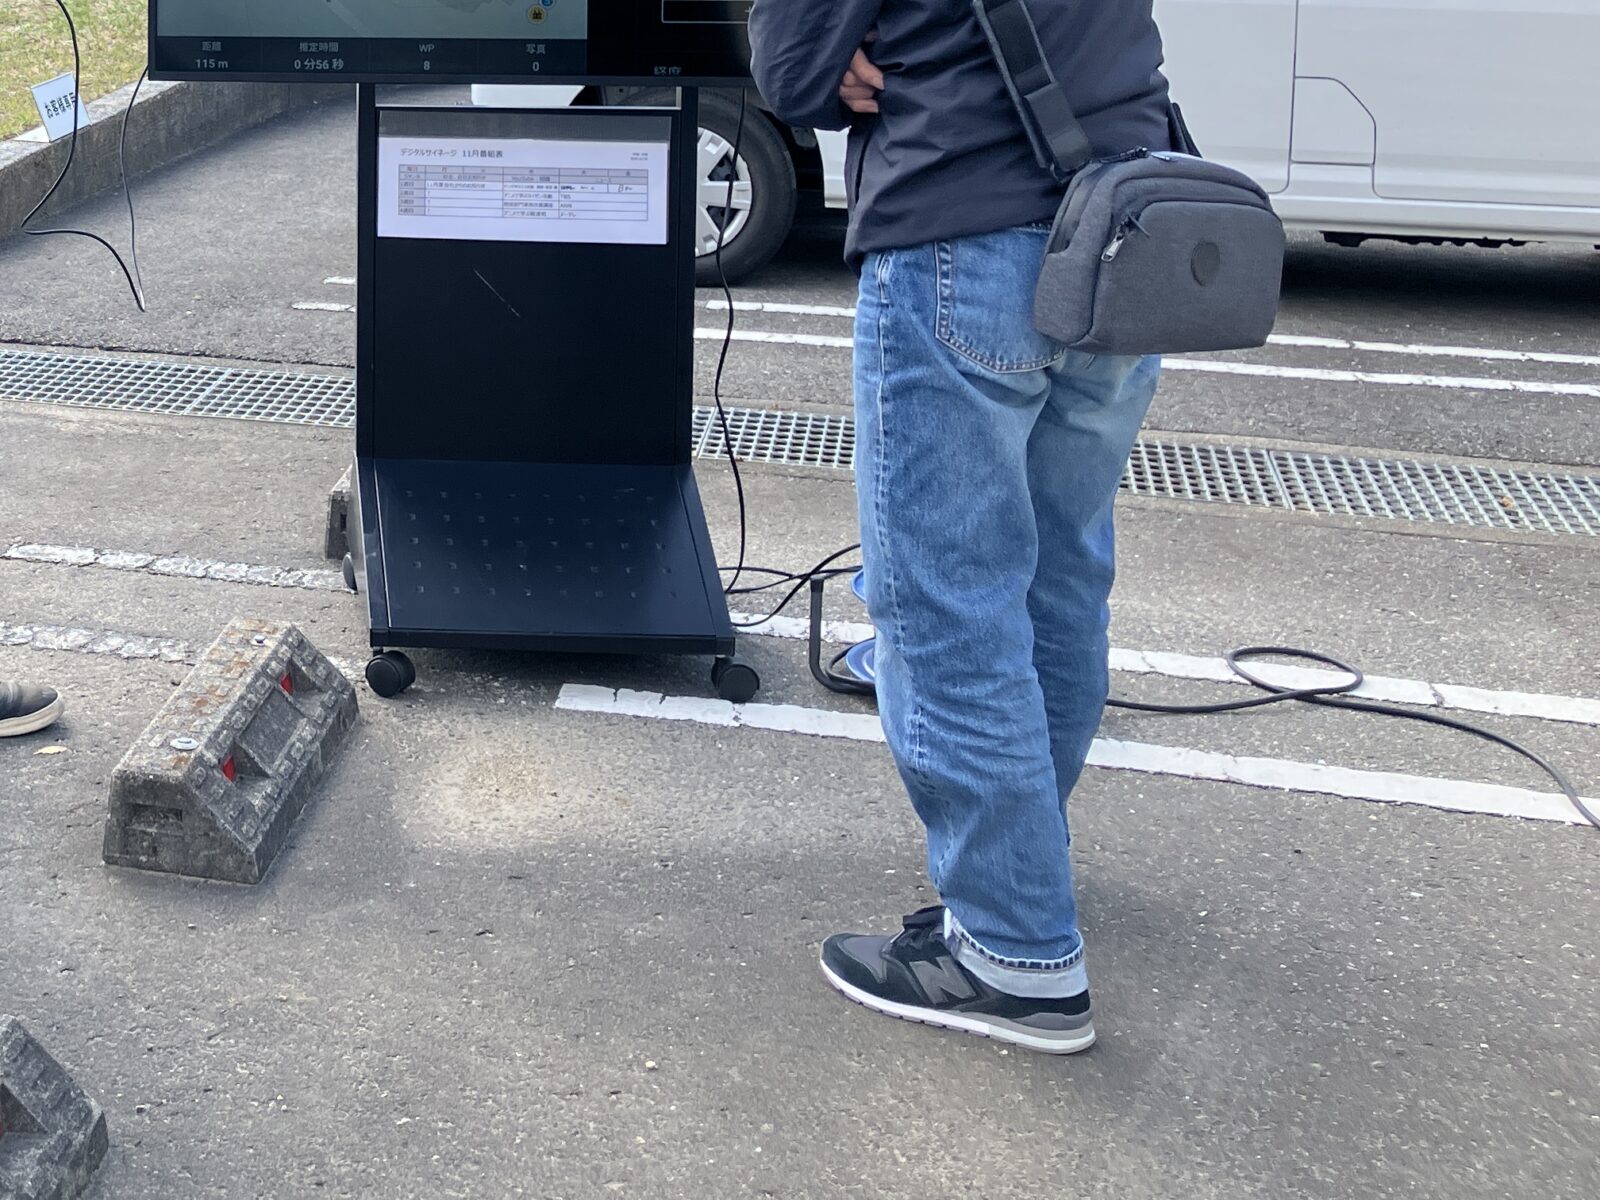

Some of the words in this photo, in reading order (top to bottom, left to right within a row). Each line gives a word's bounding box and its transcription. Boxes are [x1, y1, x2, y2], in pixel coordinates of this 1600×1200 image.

[299, 41, 339, 54] 推定時間
[418, 43, 435, 54] WP
[525, 43, 547, 56] 写真
